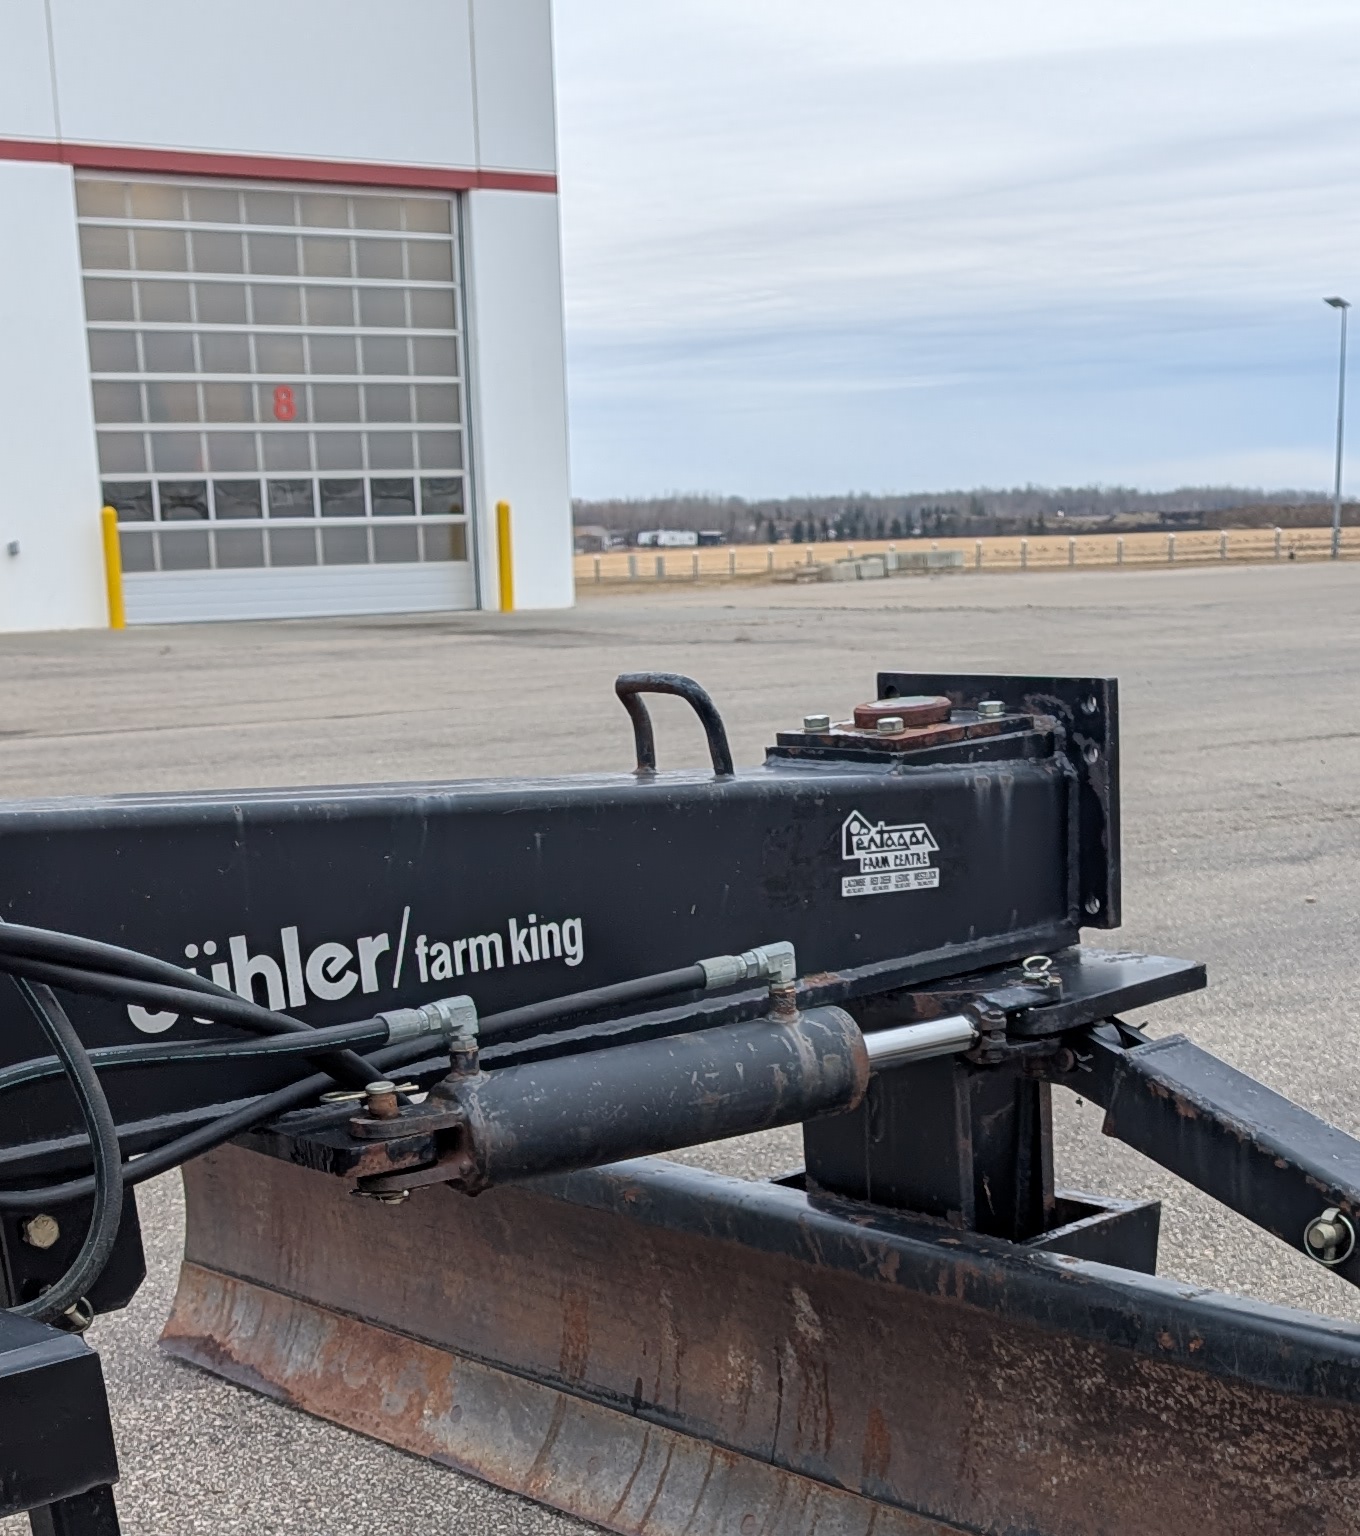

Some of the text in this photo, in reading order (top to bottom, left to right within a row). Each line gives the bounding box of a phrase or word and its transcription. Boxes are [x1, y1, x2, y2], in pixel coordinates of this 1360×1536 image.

[273, 384, 298, 422] 8
[845, 813, 936, 856] Pentagon
[863, 851, 928, 871] FARM CENTRE
[508, 914, 584, 966] king
